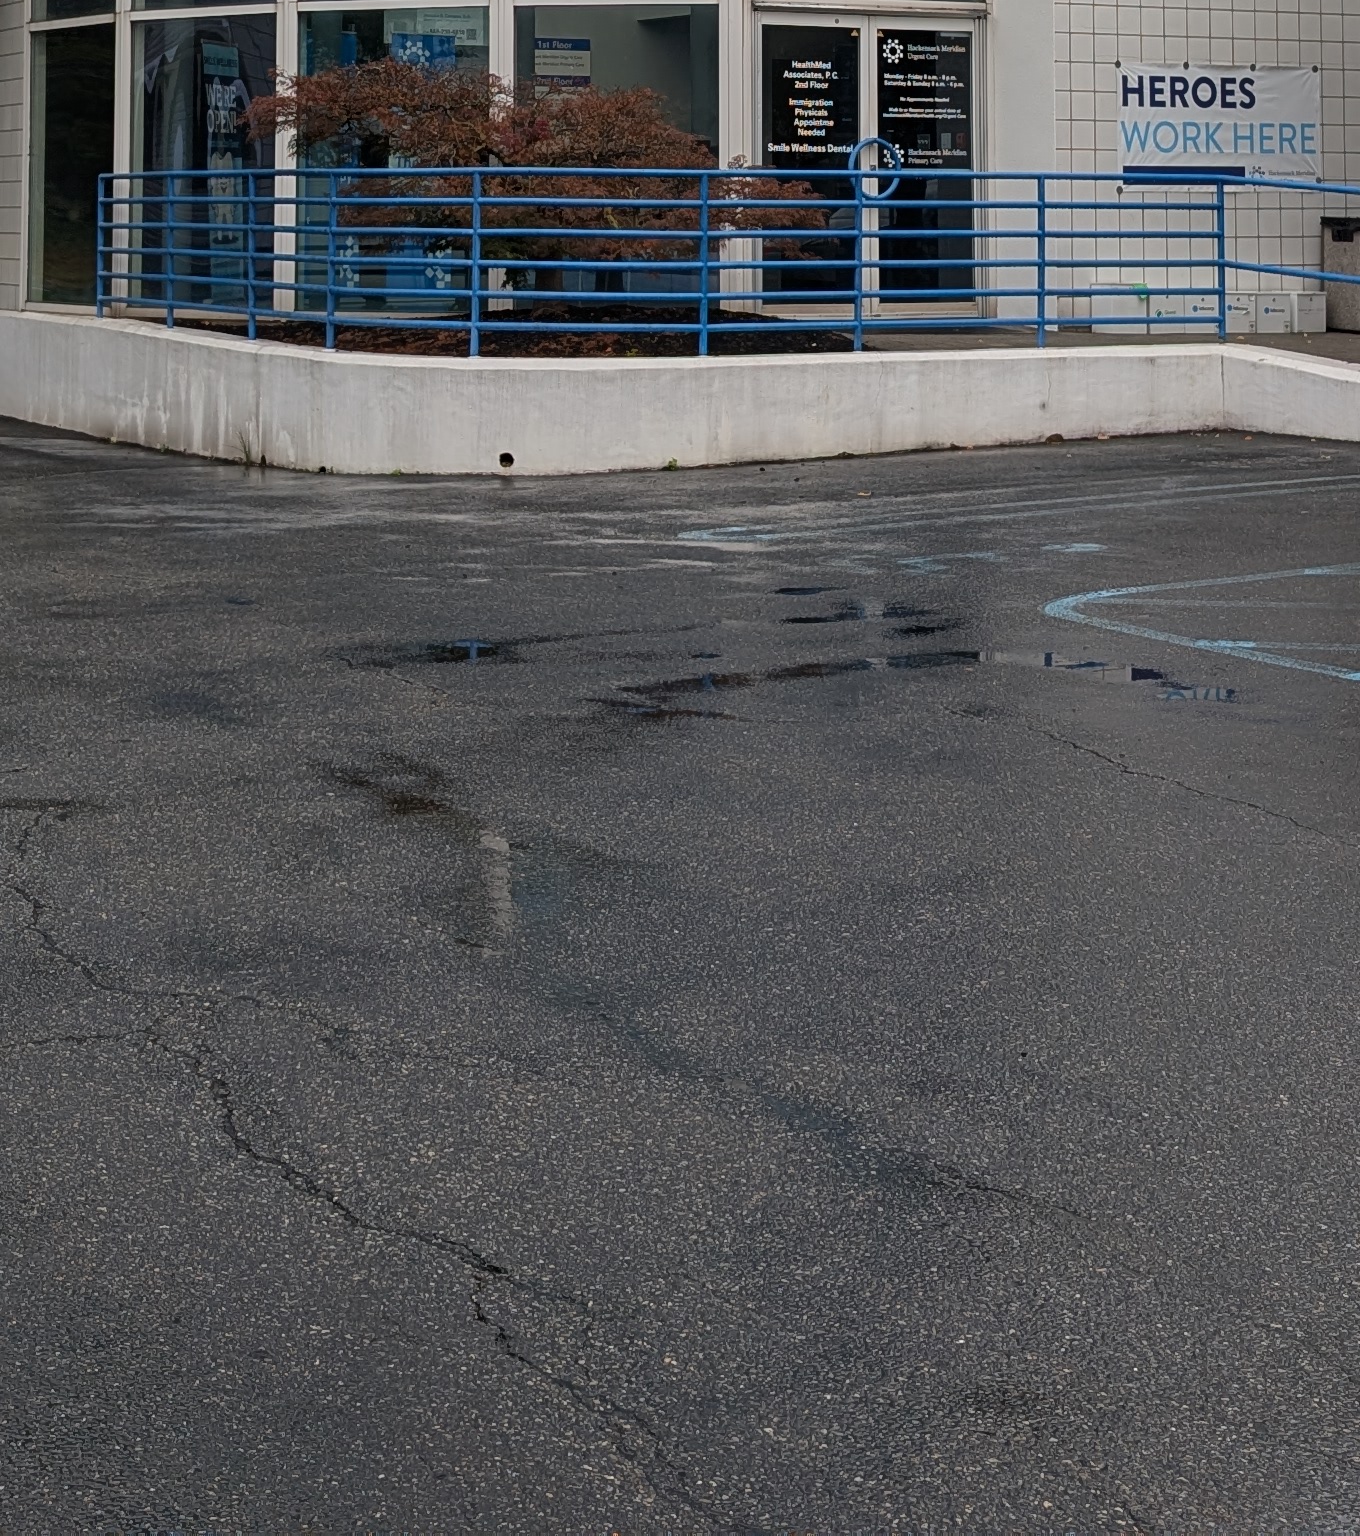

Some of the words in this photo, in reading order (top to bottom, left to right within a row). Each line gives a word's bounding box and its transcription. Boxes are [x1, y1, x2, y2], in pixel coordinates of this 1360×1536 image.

[537, 40, 550, 49] 1st
[552, 40, 573, 49] Floor
[791, 60, 832, 69] HealthMed
[783, 70, 825, 80] Associates,
[794, 80, 809, 89] 2nd
[809, 80, 829, 89] Floor
[1121, 74, 1256, 109] HEROES
[788, 97, 834, 107] Immigration
[794, 108, 828, 118] Physicals
[797, 127, 826, 136] Needed
[1120, 120, 1224, 154] WORK
[1233, 121, 1317, 154] HERE
[767, 142, 790, 152] Smile
[791, 143, 826, 153] Wellness
[827, 143, 854, 153] Dental
[907, 157, 929, 165] Primary
